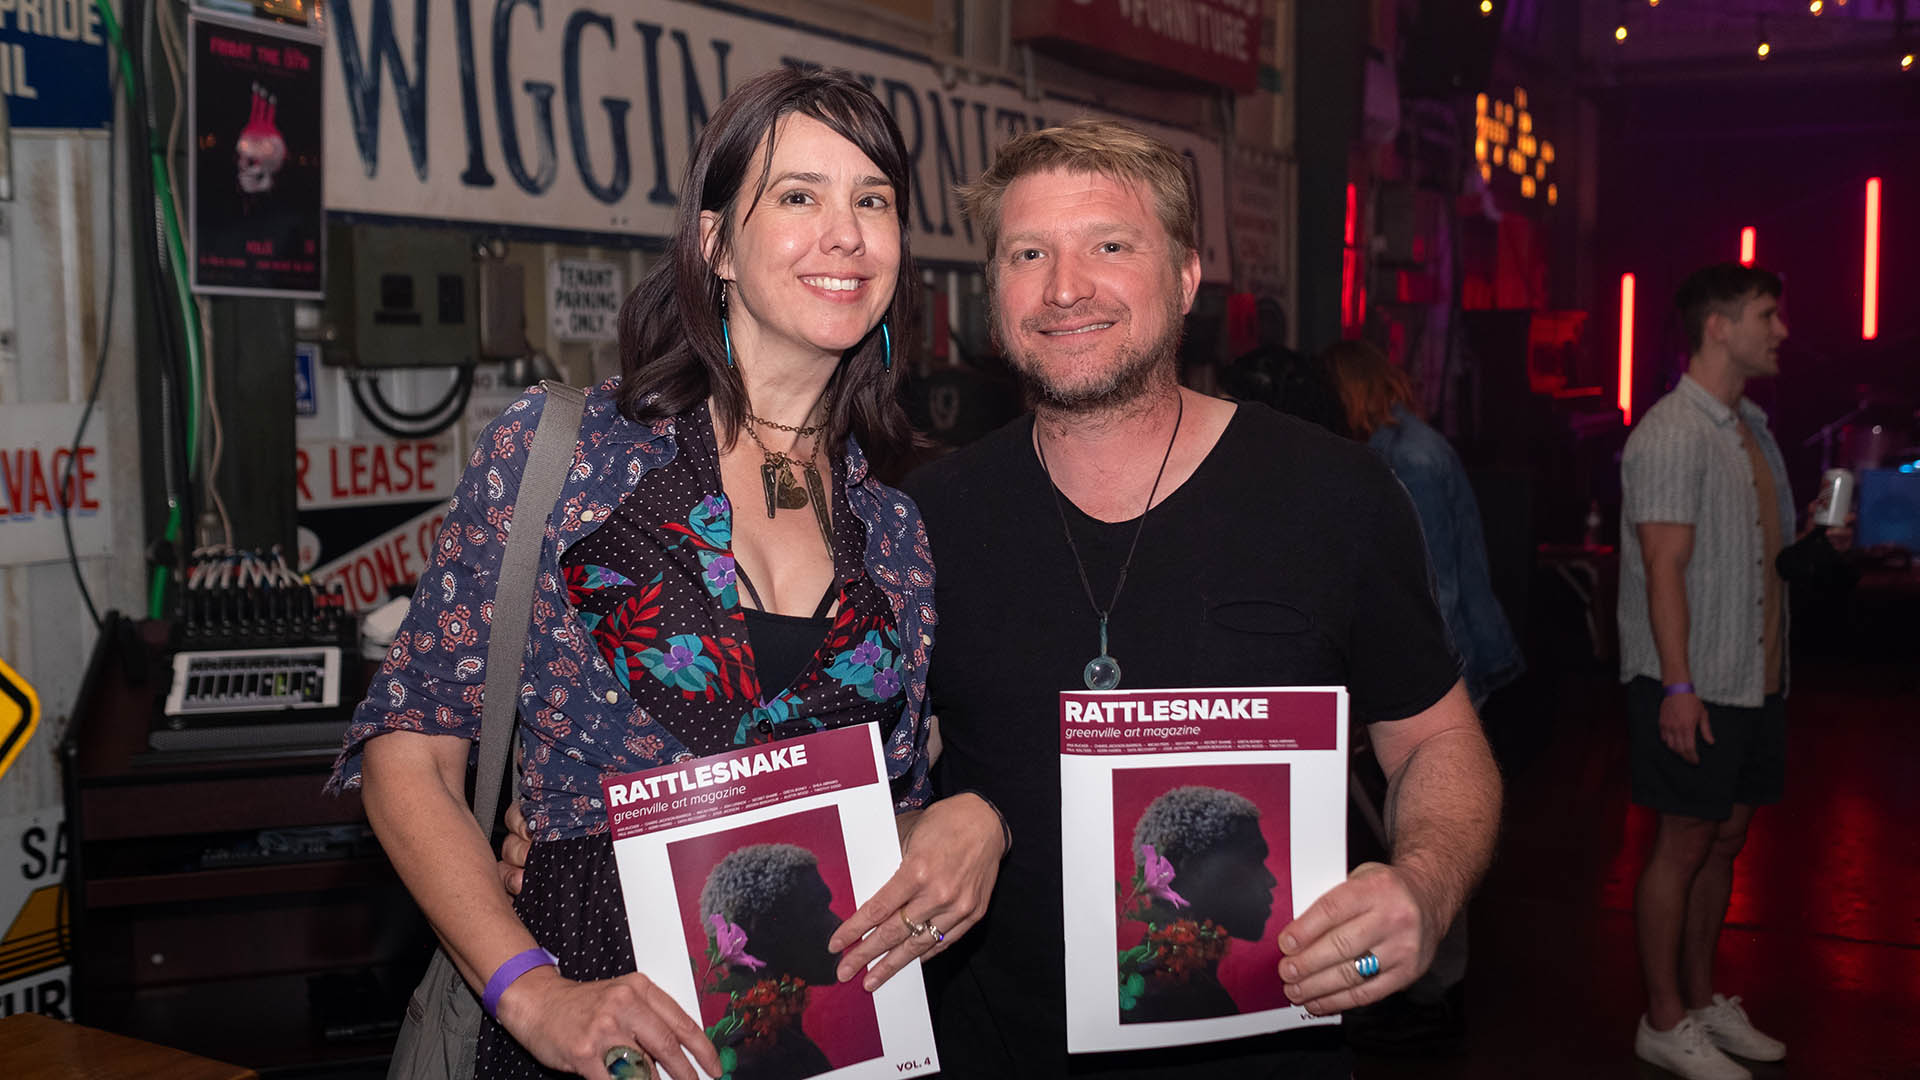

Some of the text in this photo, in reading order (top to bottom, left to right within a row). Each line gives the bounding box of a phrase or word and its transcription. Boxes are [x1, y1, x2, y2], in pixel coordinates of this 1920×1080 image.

[329, 0, 732, 206] WIGGIN
[560, 264, 613, 288] TENANT
[555, 288, 616, 313] PARKING
[569, 311, 605, 335] ONLY
[0, 446, 99, 515] VAGE
[329, 440, 438, 500] LEASE
[323, 533, 418, 616] TONE
[1065, 698, 1269, 723] RATTLESNAKE
[1065, 725, 1201, 740] greenville art magazine
[608, 744, 809, 807] RATTLESNAKE
[613, 802, 669, 825] greenville
[671, 796, 688, 810] art
[690, 783, 747, 805] magazine
[896, 1056, 931, 1073] VOL. 4
